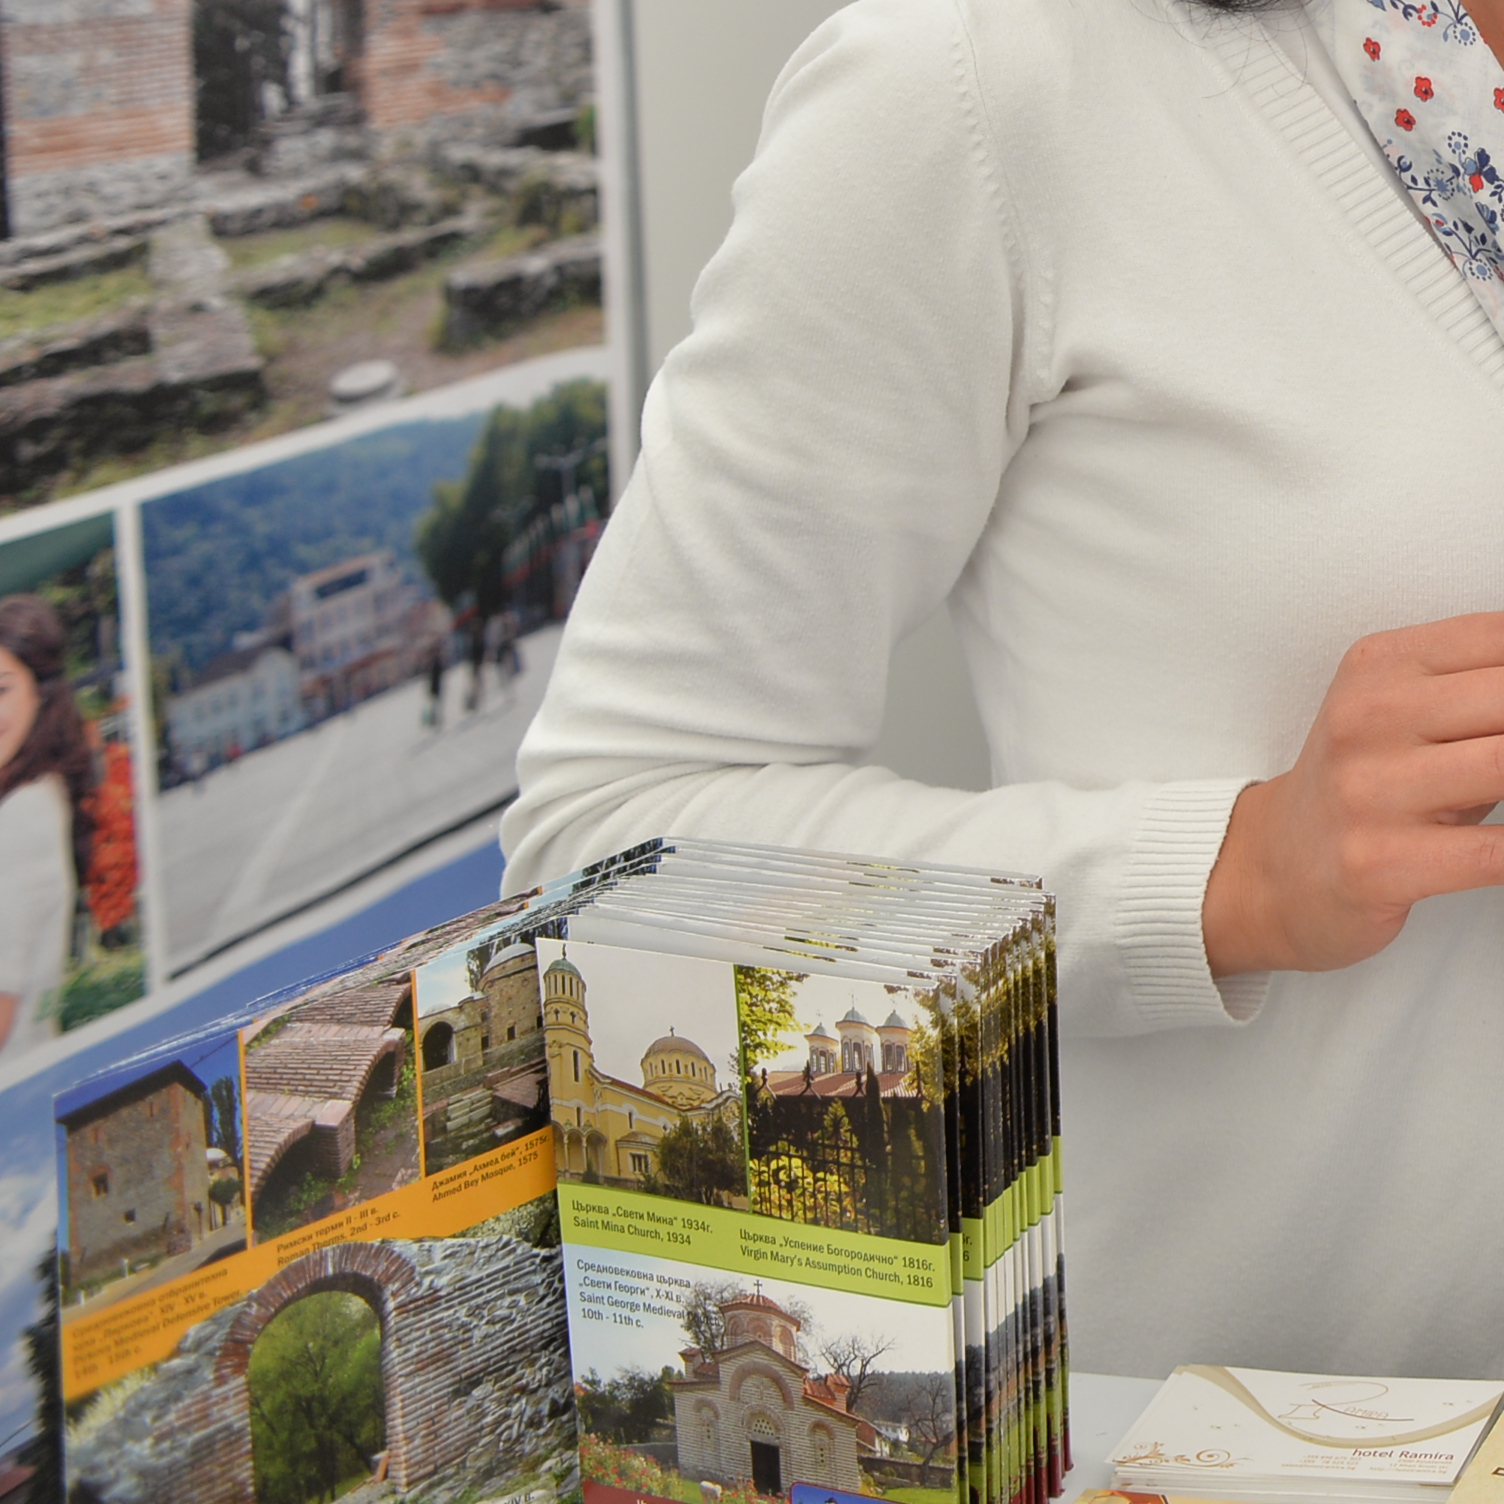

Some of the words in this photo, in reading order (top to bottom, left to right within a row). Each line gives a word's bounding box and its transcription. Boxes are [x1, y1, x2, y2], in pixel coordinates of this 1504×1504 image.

[432, 1184, 462, 1203] Ahmed
[464, 1177, 479, 1192] Bey
[518, 1151, 538, 1166] 1575
[572, 1200, 609, 1215] Църква
[612, 1206, 644, 1220] „Свети
[682, 1218, 713, 1233] 1934г.
[574, 1217, 599, 1230] Saint
[602, 1221, 625, 1234] Mina
[628, 1225, 664, 1242] Church,
[667, 1232, 691, 1245] 1934
[740, 1228, 776, 1245] Църква
[902, 1257, 935, 1272] 1816г.
[577, 1259, 654, 1282] Средновековна
[657, 1274, 691, 1289] църква
[740, 1246, 768, 1260] Virgin
[805, 1257, 862, 1276] Assumption
[865, 1268, 904, 1286] Church,
[907, 1274, 933, 1288] 1816
[579, 1276, 612, 1290] „Свети
[580, 1292, 605, 1306] Saint
[607, 1295, 641, 1312] George
[643, 1300, 685, 1320] Medieval
[582, 1308, 603, 1320] 10th
[613, 1313, 633, 1326] 11th
[1352, 1448, 1393, 1458] hotel
[1399, 1451, 1454, 1460] Ramira
